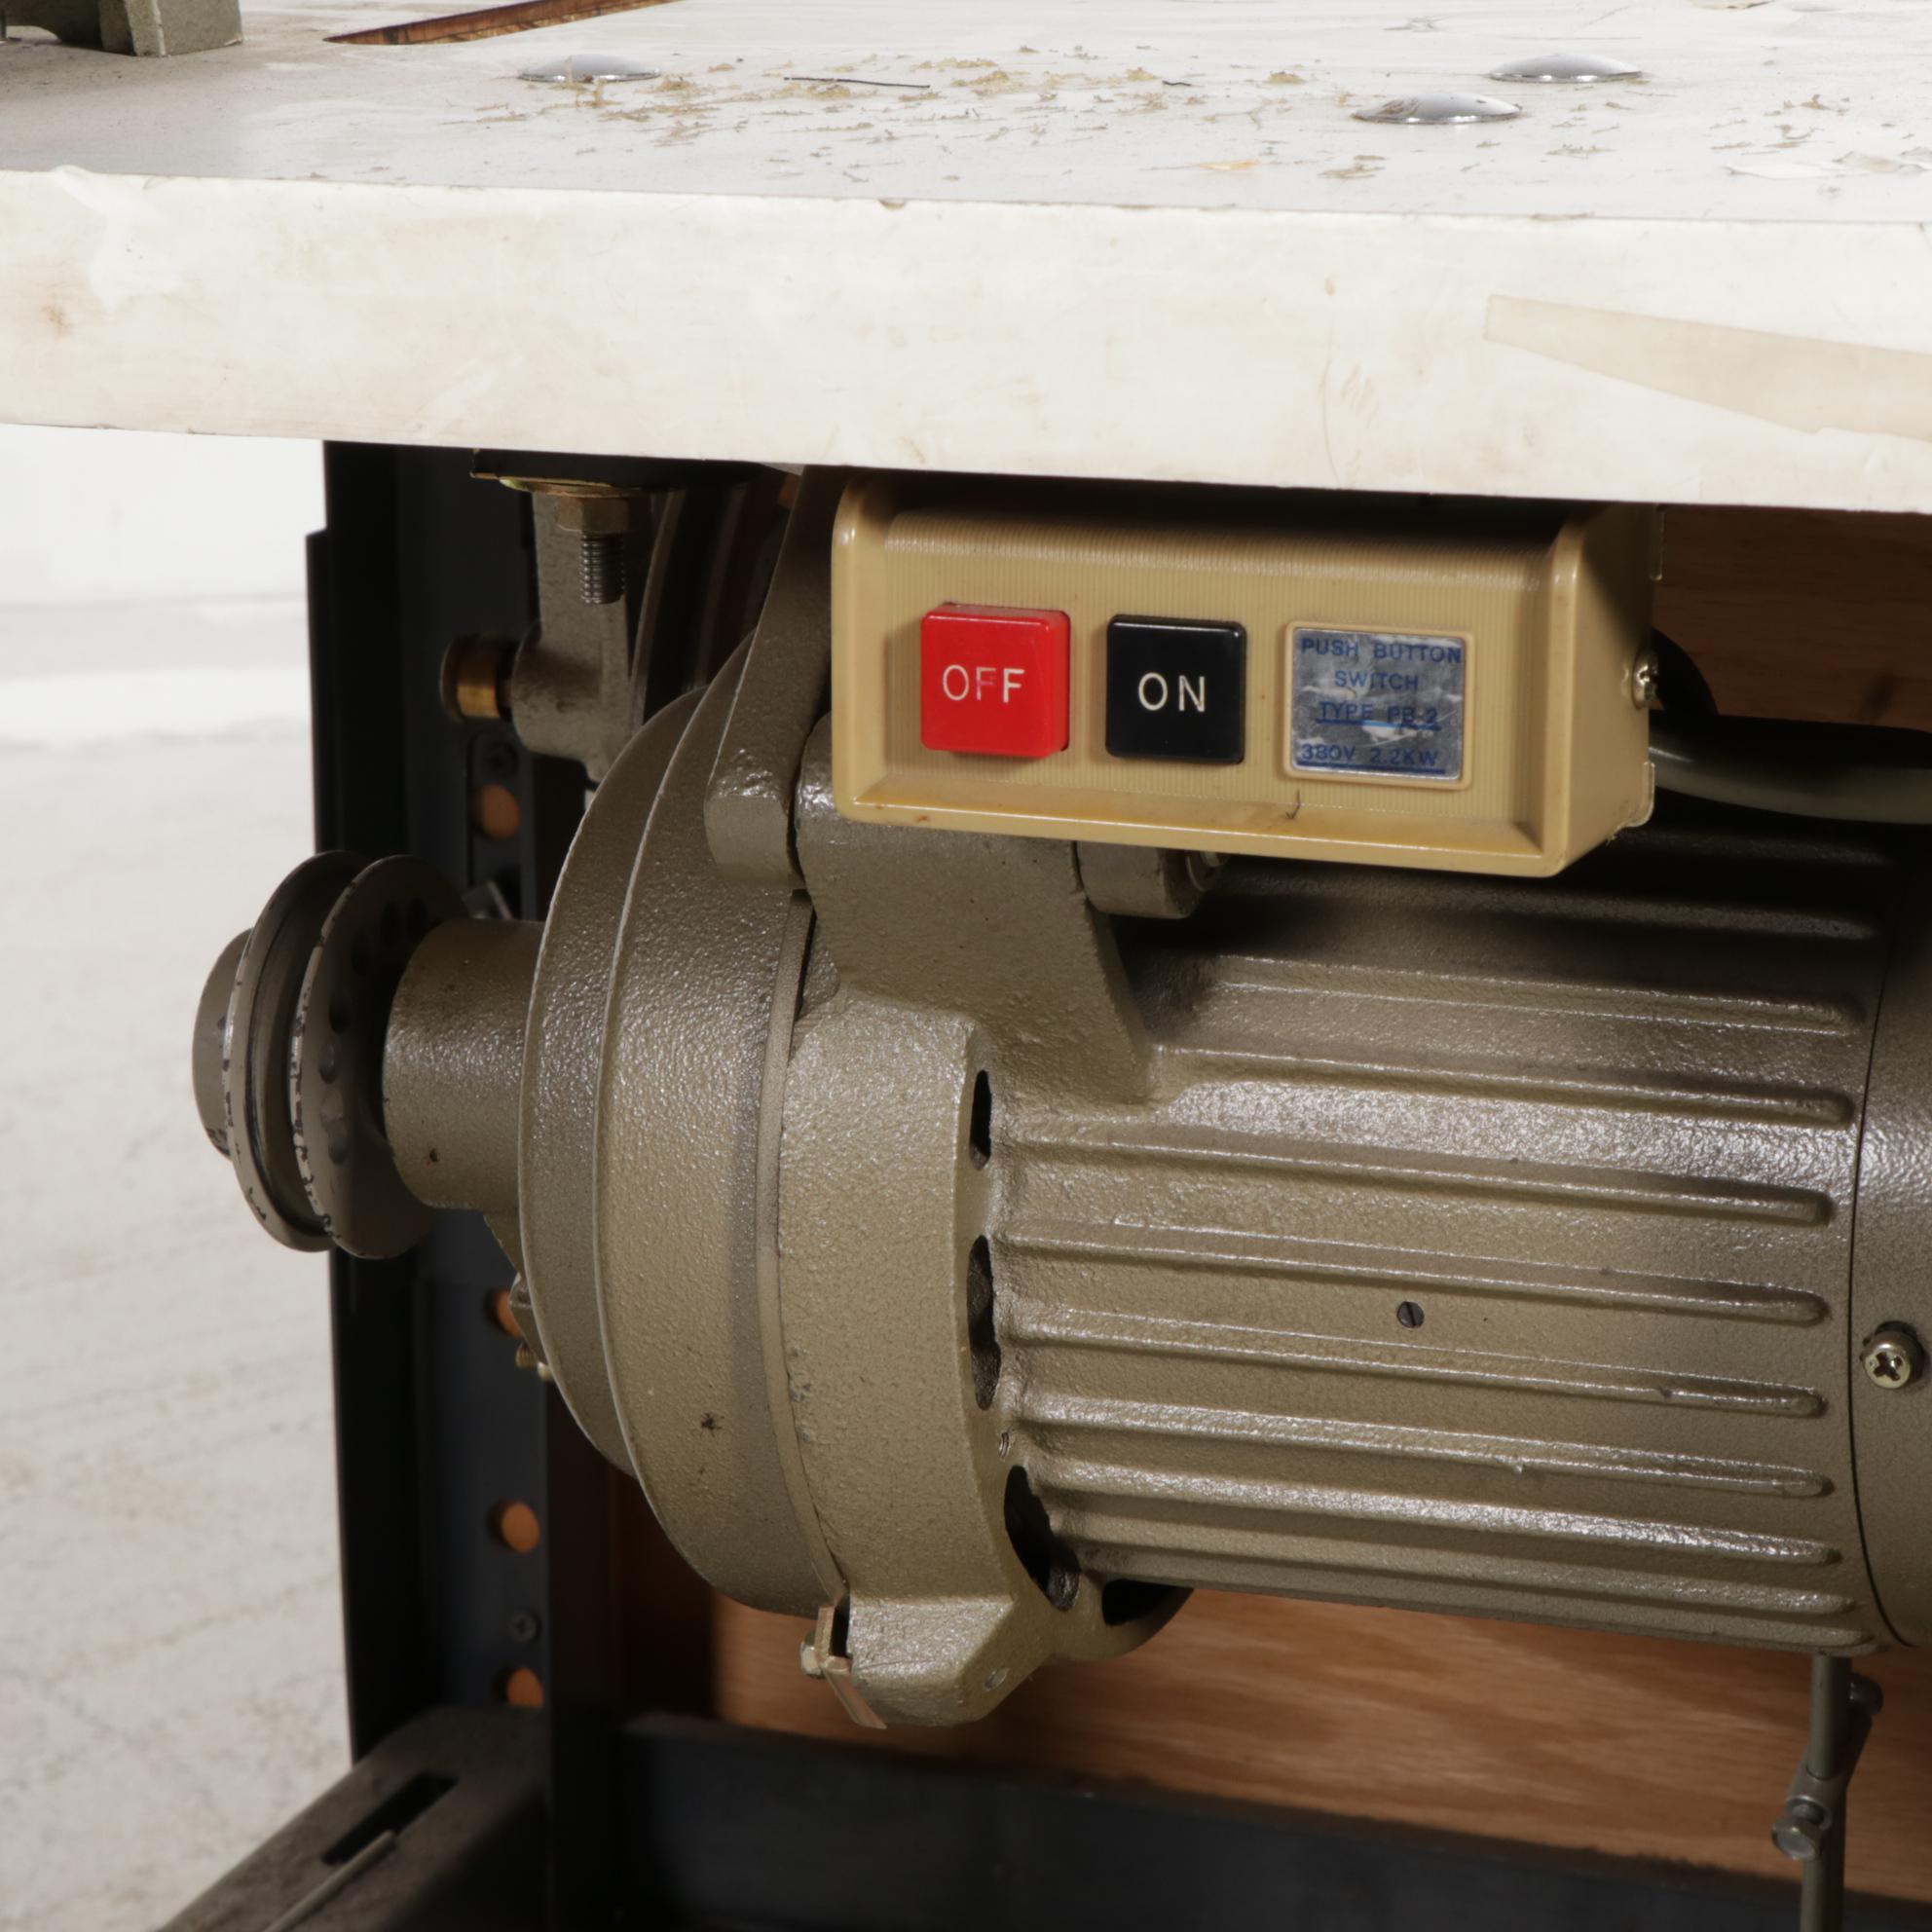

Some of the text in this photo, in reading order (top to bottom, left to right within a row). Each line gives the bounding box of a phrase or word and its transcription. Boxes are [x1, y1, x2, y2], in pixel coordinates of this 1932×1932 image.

[1301, 638, 1461, 663] PUSH BUTTON
[943, 664, 1024, 703] OFF
[1334, 670, 1418, 690] SWITCH
[1138, 673, 1205, 712] ON
[1319, 701, 1373, 721] TYPE
[1301, 744, 1437, 765] 380V 2.2KW
